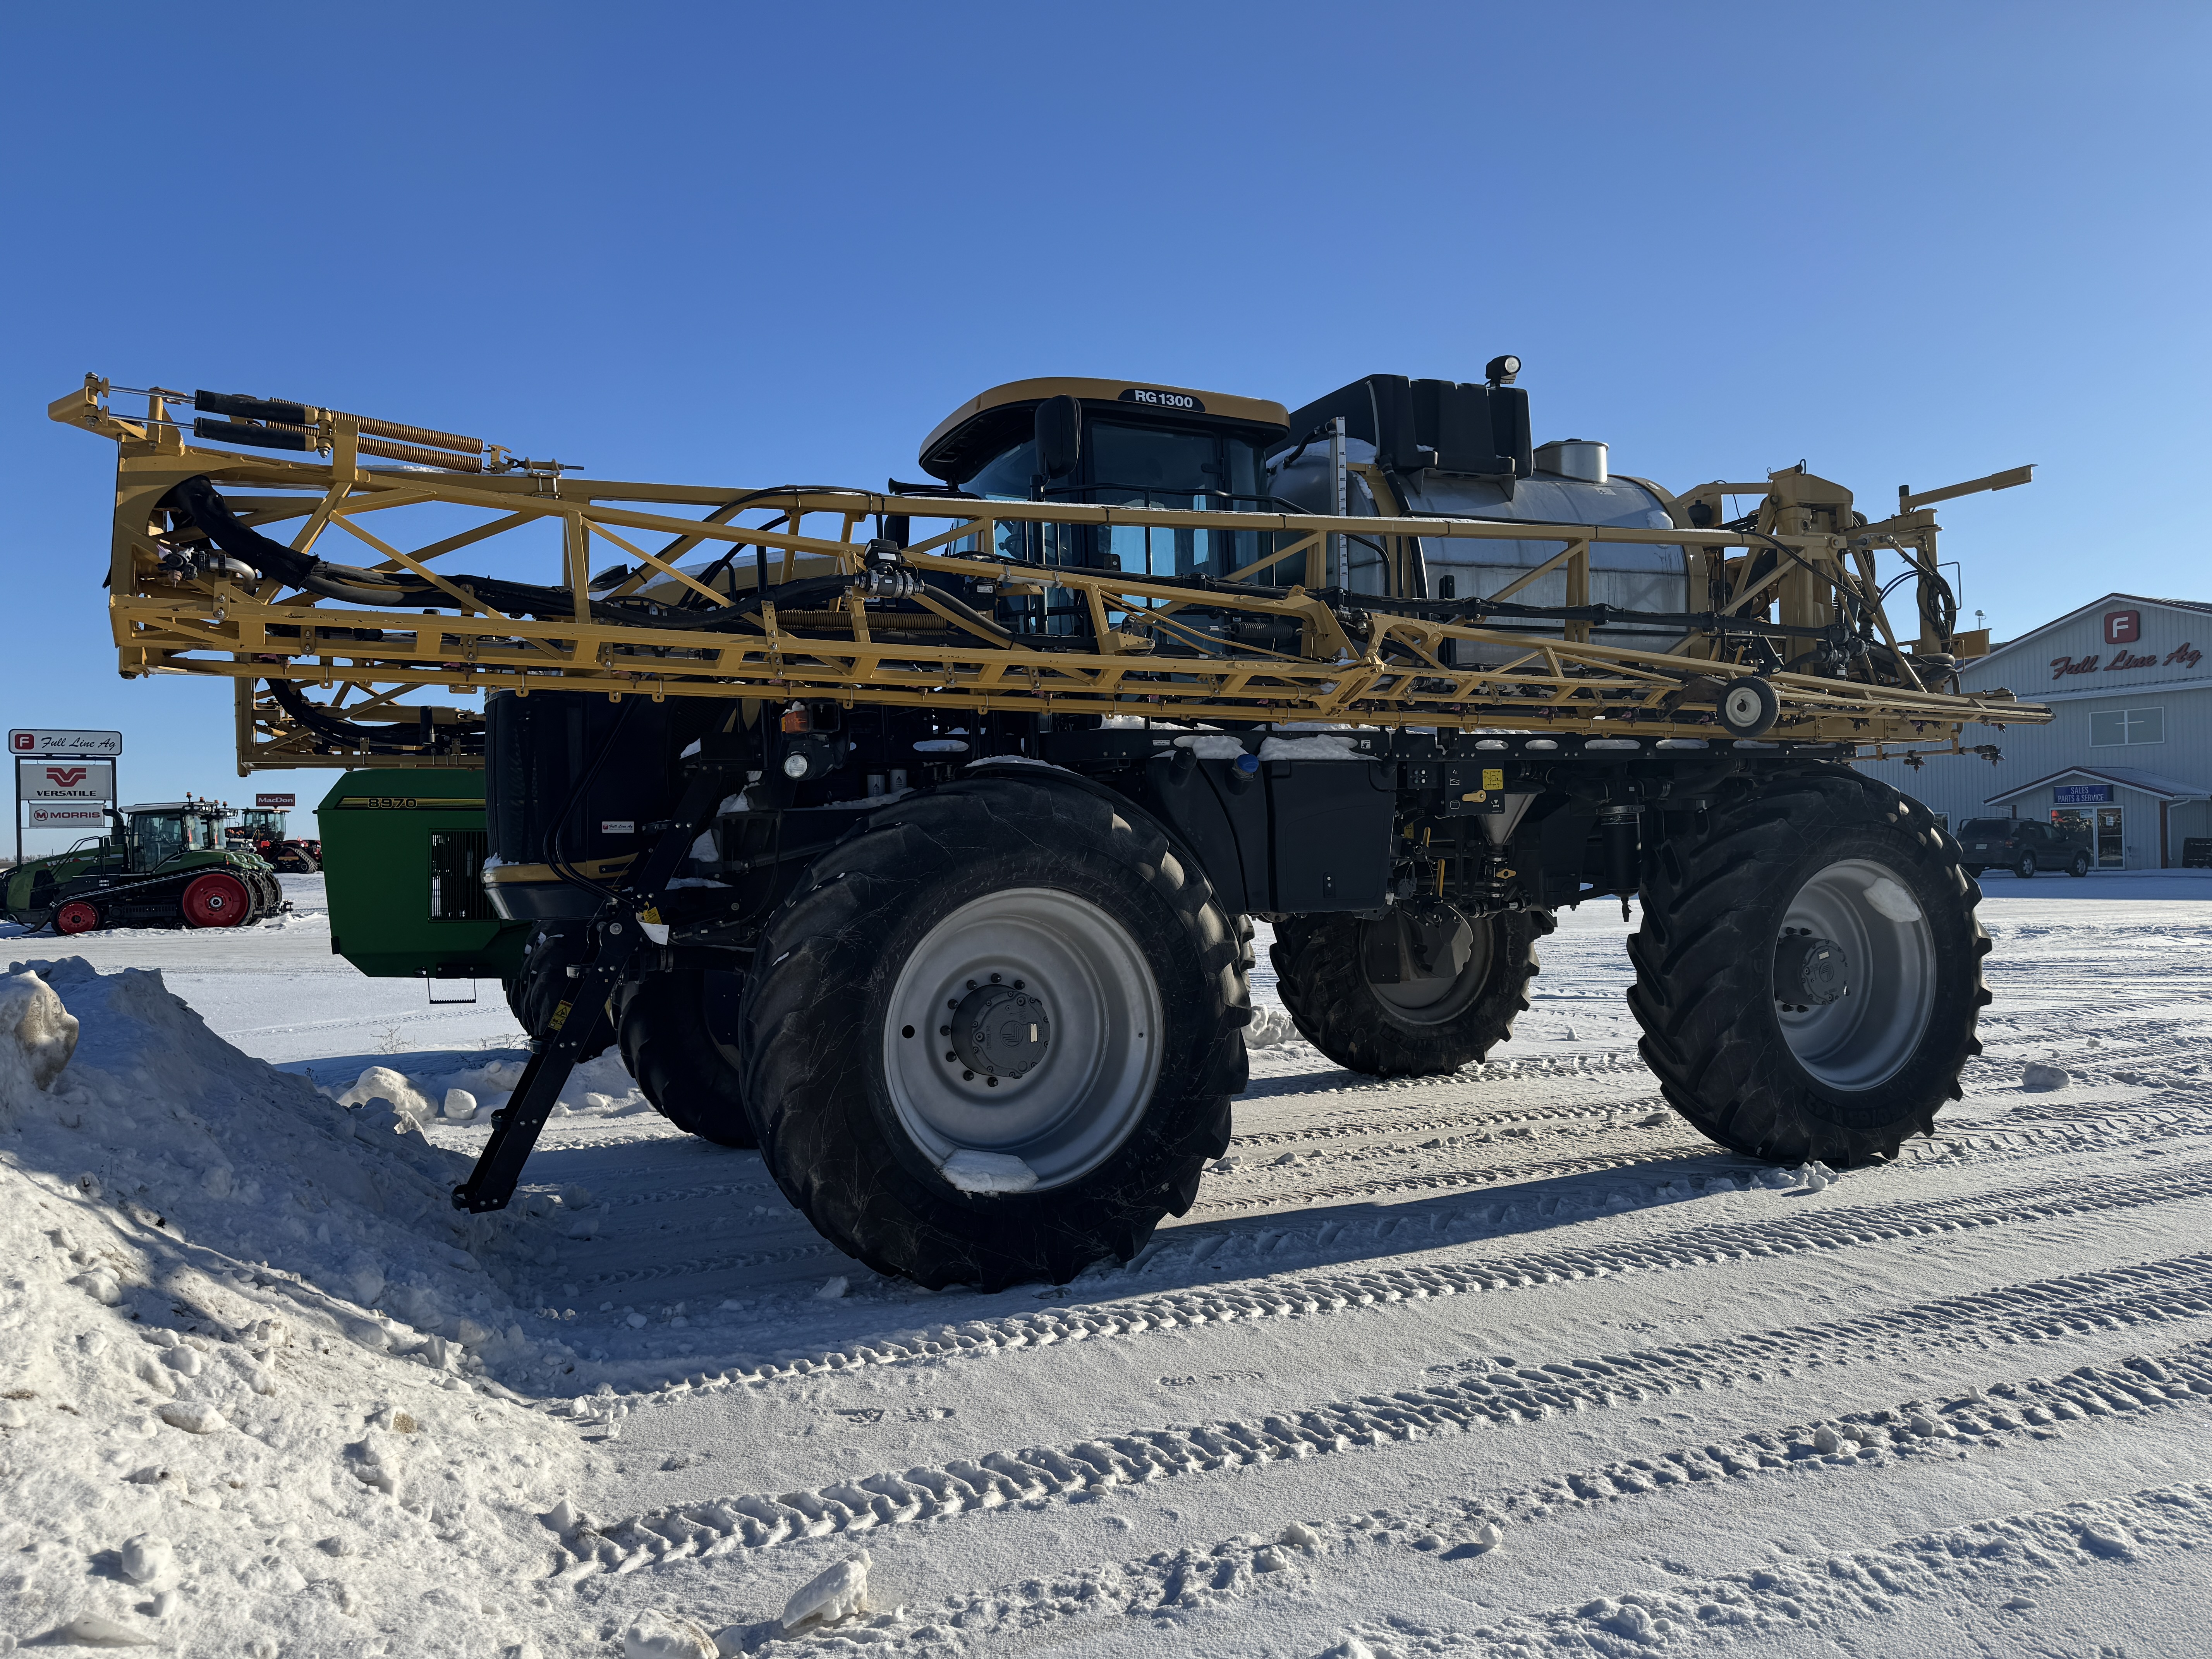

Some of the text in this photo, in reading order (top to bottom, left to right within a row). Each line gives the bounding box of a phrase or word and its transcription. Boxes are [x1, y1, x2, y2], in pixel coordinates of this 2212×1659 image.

[1135, 390, 1193, 408] RG 1300
[2112, 617, 2129, 638] F
[2050, 642, 2203, 680] Full Line Ag
[19, 737, 29, 747] F
[41, 737, 116, 751] Full Line Ag
[368, 798, 417, 809] 8970
